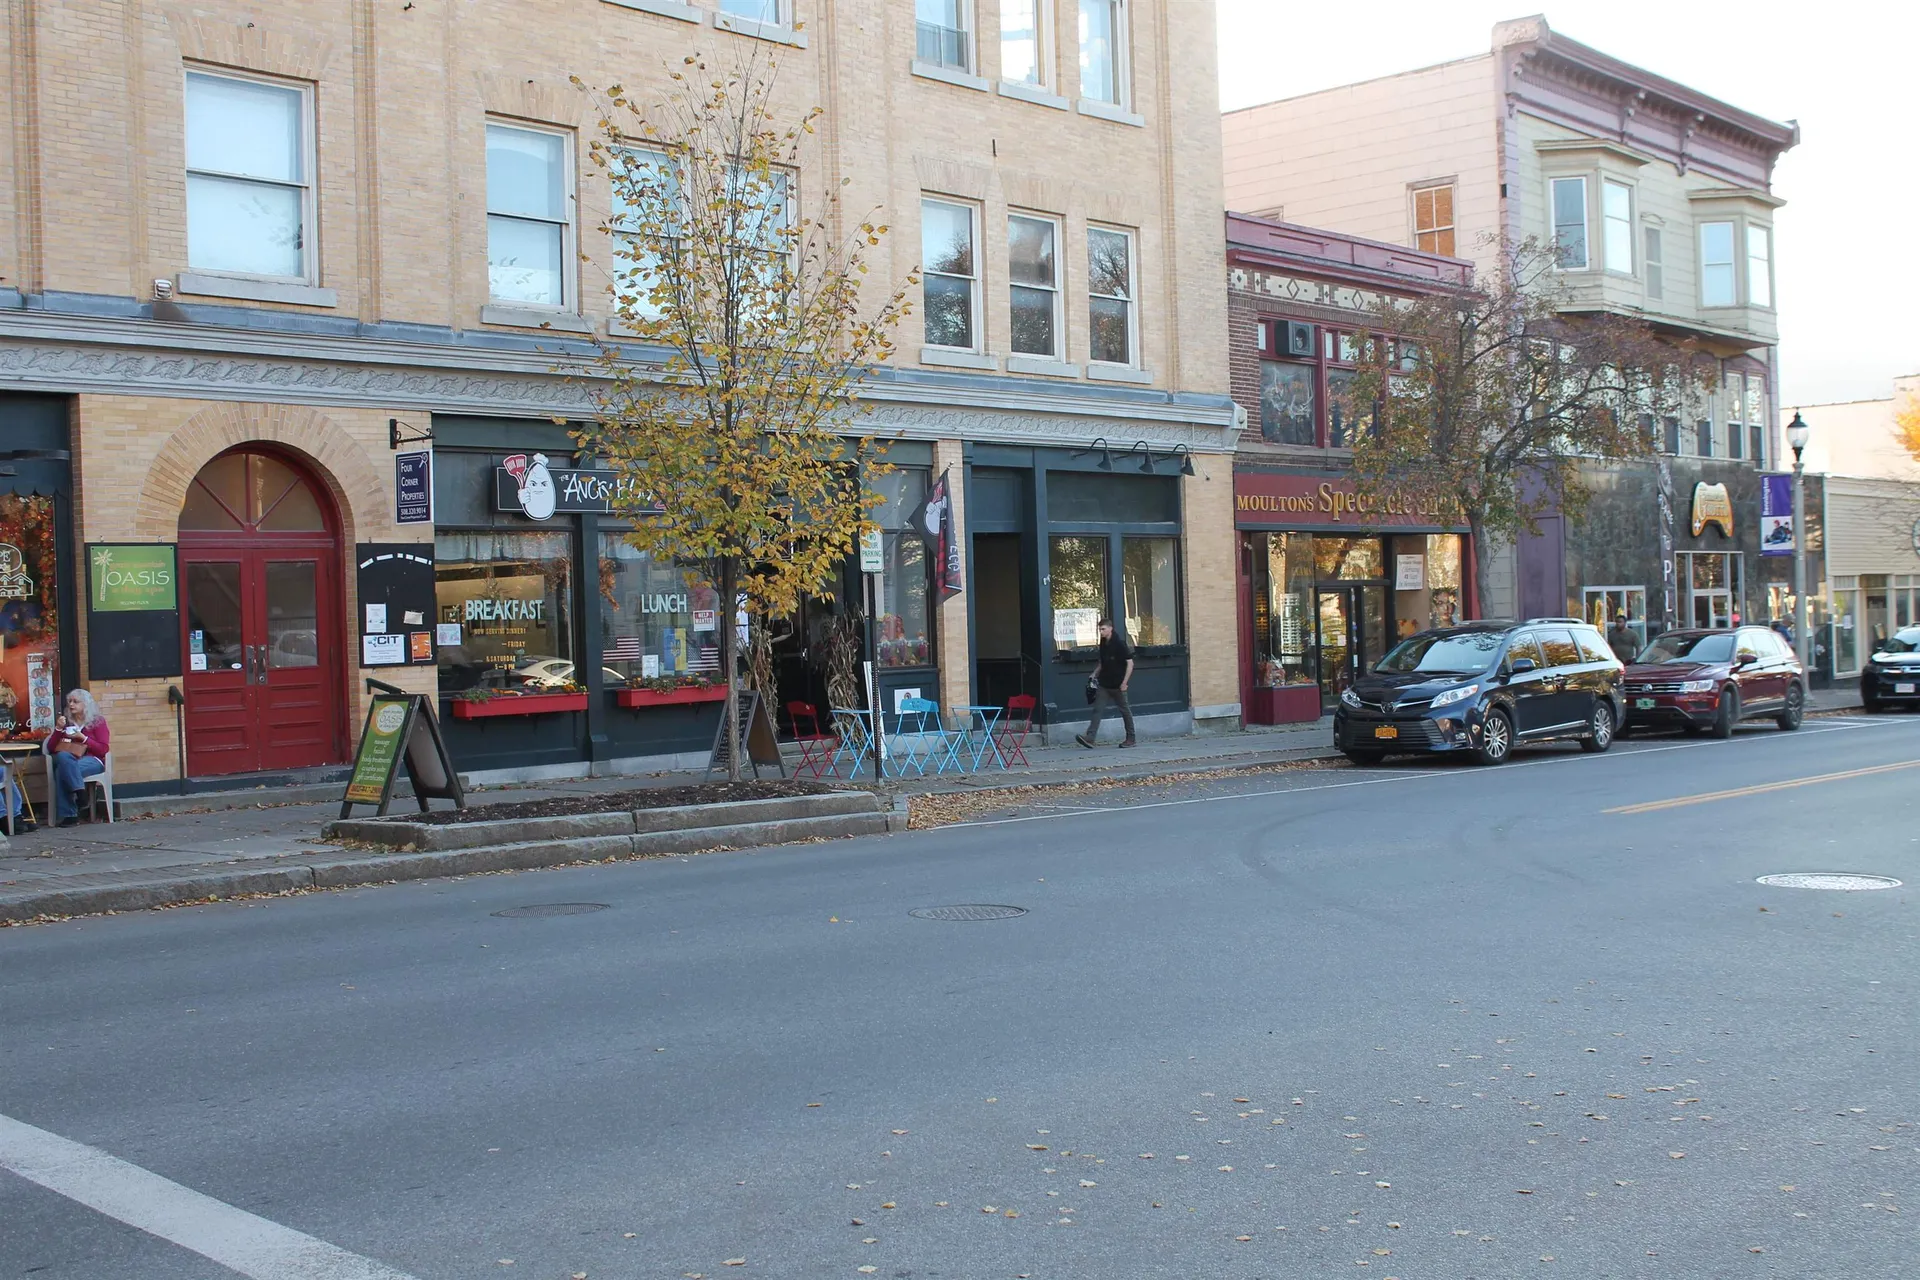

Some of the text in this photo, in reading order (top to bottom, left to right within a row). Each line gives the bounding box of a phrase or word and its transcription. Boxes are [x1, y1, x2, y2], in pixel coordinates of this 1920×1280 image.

[400, 462, 413, 472] FOUR
[401, 476, 419, 487] CORNER
[401, 491, 425, 501] PROPERTIES
[1236, 492, 1315, 512] MOULTON'S
[1319, 482, 1413, 521] Speccle
[106, 570, 170, 586] OASIS
[465, 599, 543, 620] BREAKFAST
[641, 594, 687, 613] LUNCH
[377, 636, 400, 645] CIT
